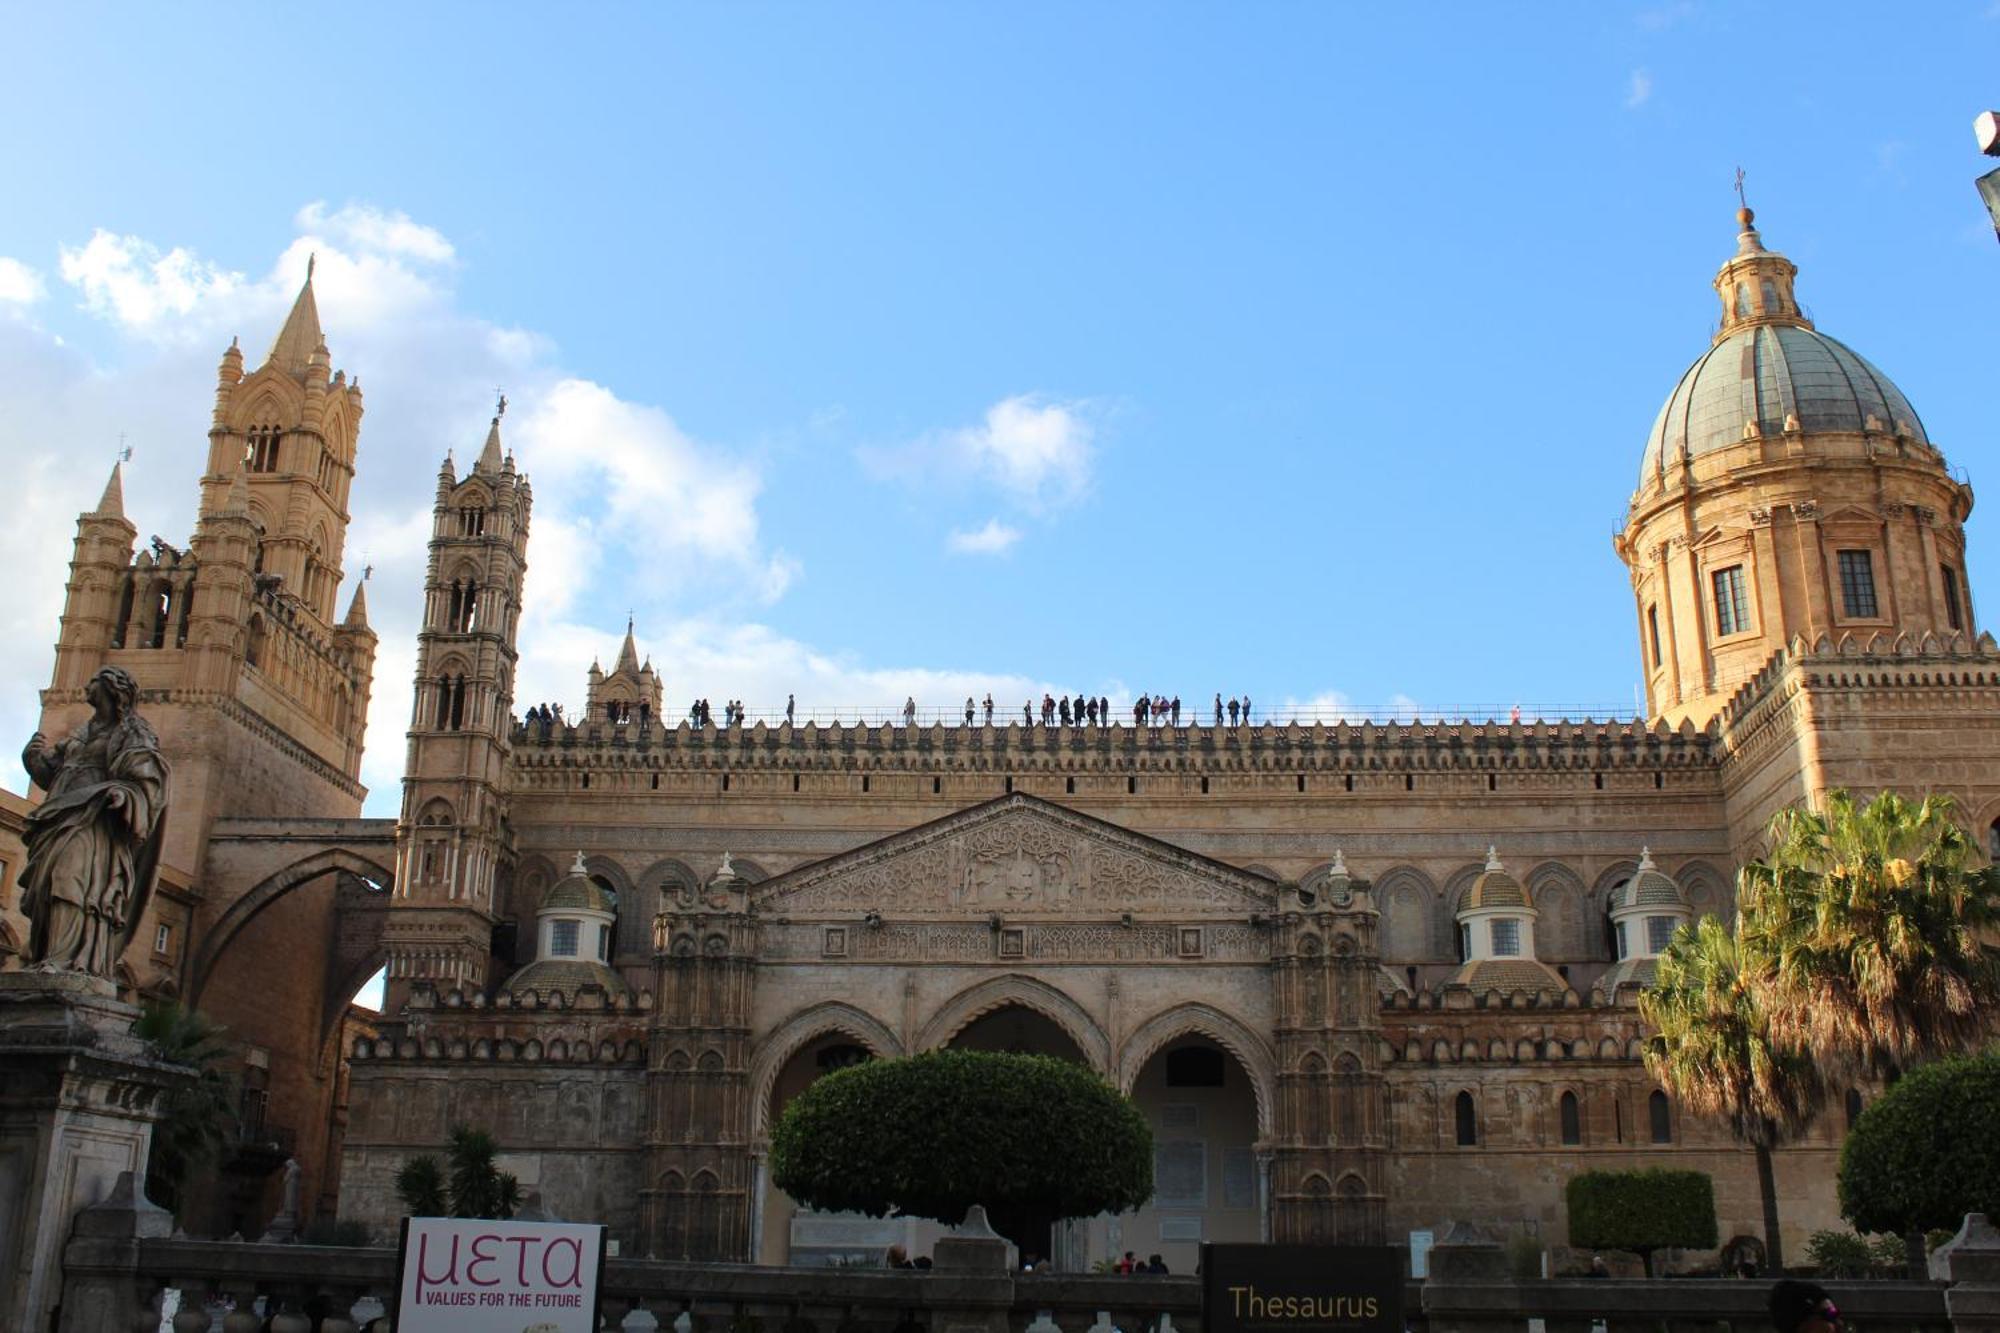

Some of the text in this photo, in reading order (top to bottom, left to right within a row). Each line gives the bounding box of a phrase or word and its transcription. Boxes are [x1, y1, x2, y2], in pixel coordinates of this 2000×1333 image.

[426, 1291, 582, 1308] VALUES FOR THE FUTURE
[1228, 1285, 1378, 1318] Thesaurus
